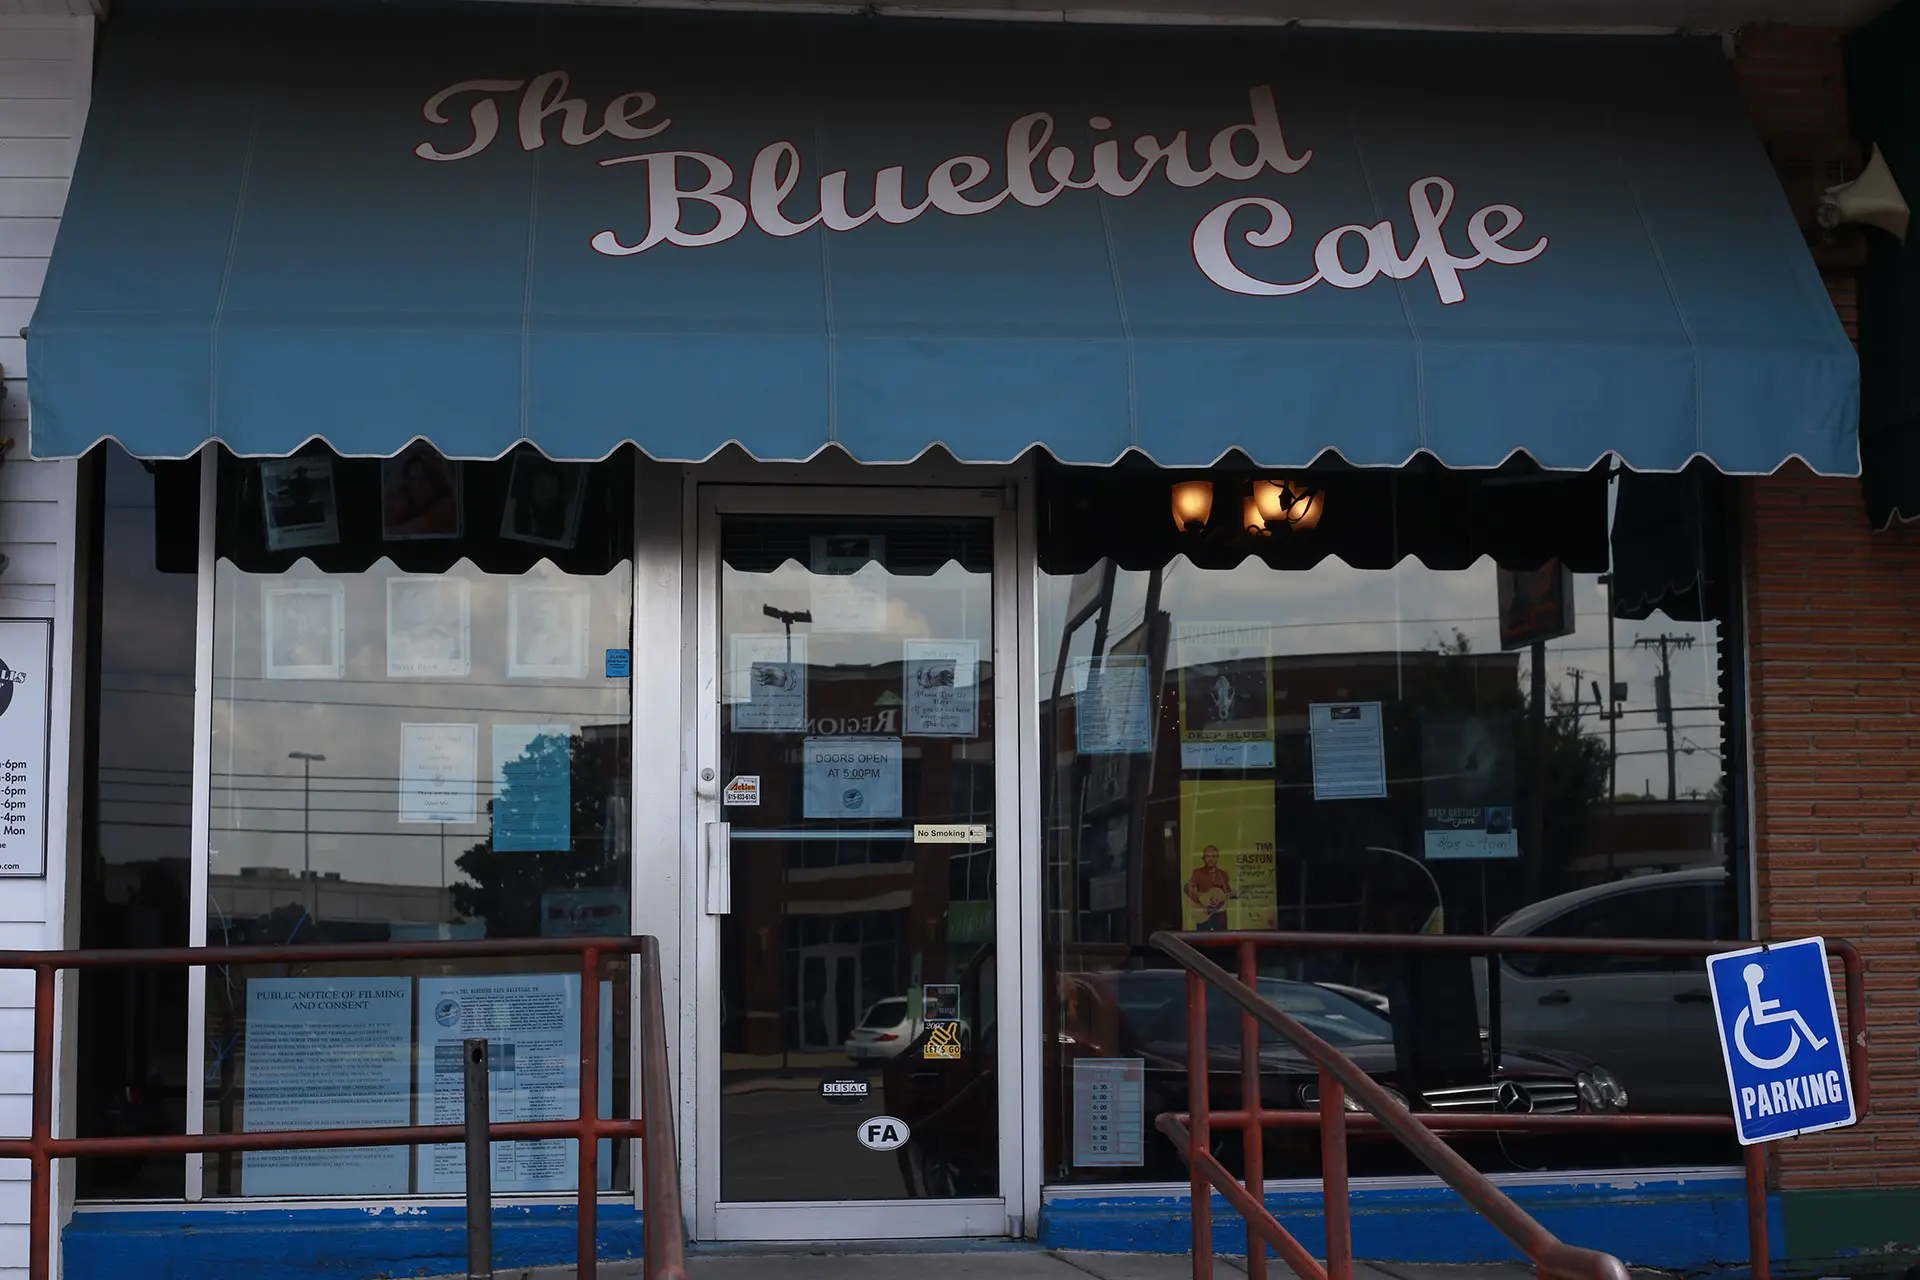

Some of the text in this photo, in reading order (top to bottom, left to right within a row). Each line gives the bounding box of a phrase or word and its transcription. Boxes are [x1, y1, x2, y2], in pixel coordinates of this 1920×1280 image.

[413, 69, 673, 162] The
[589, 83, 1314, 257] Bluebird
[1191, 175, 1549, 305] Cafe
[815, 753, 888, 763] DOORS OPEN
[0, 772, 27, 784] -8pm
[827, 768, 880, 779] AT 5:00PM
[3, 825, 25, 835] Mon
[930, 829, 966, 839] Smoking
[1255, 841, 1273, 852] TIM
[1236, 853, 1273, 864] EASTON
[256, 989, 405, 1000] PUBLIC NOTICE OF FILMING
[291, 1001, 369, 1010] AND CONSENT
[824, 1084, 867, 1092] SESAC
[1741, 1070, 1843, 1120] PARKING
[868, 1125, 899, 1142] FA
